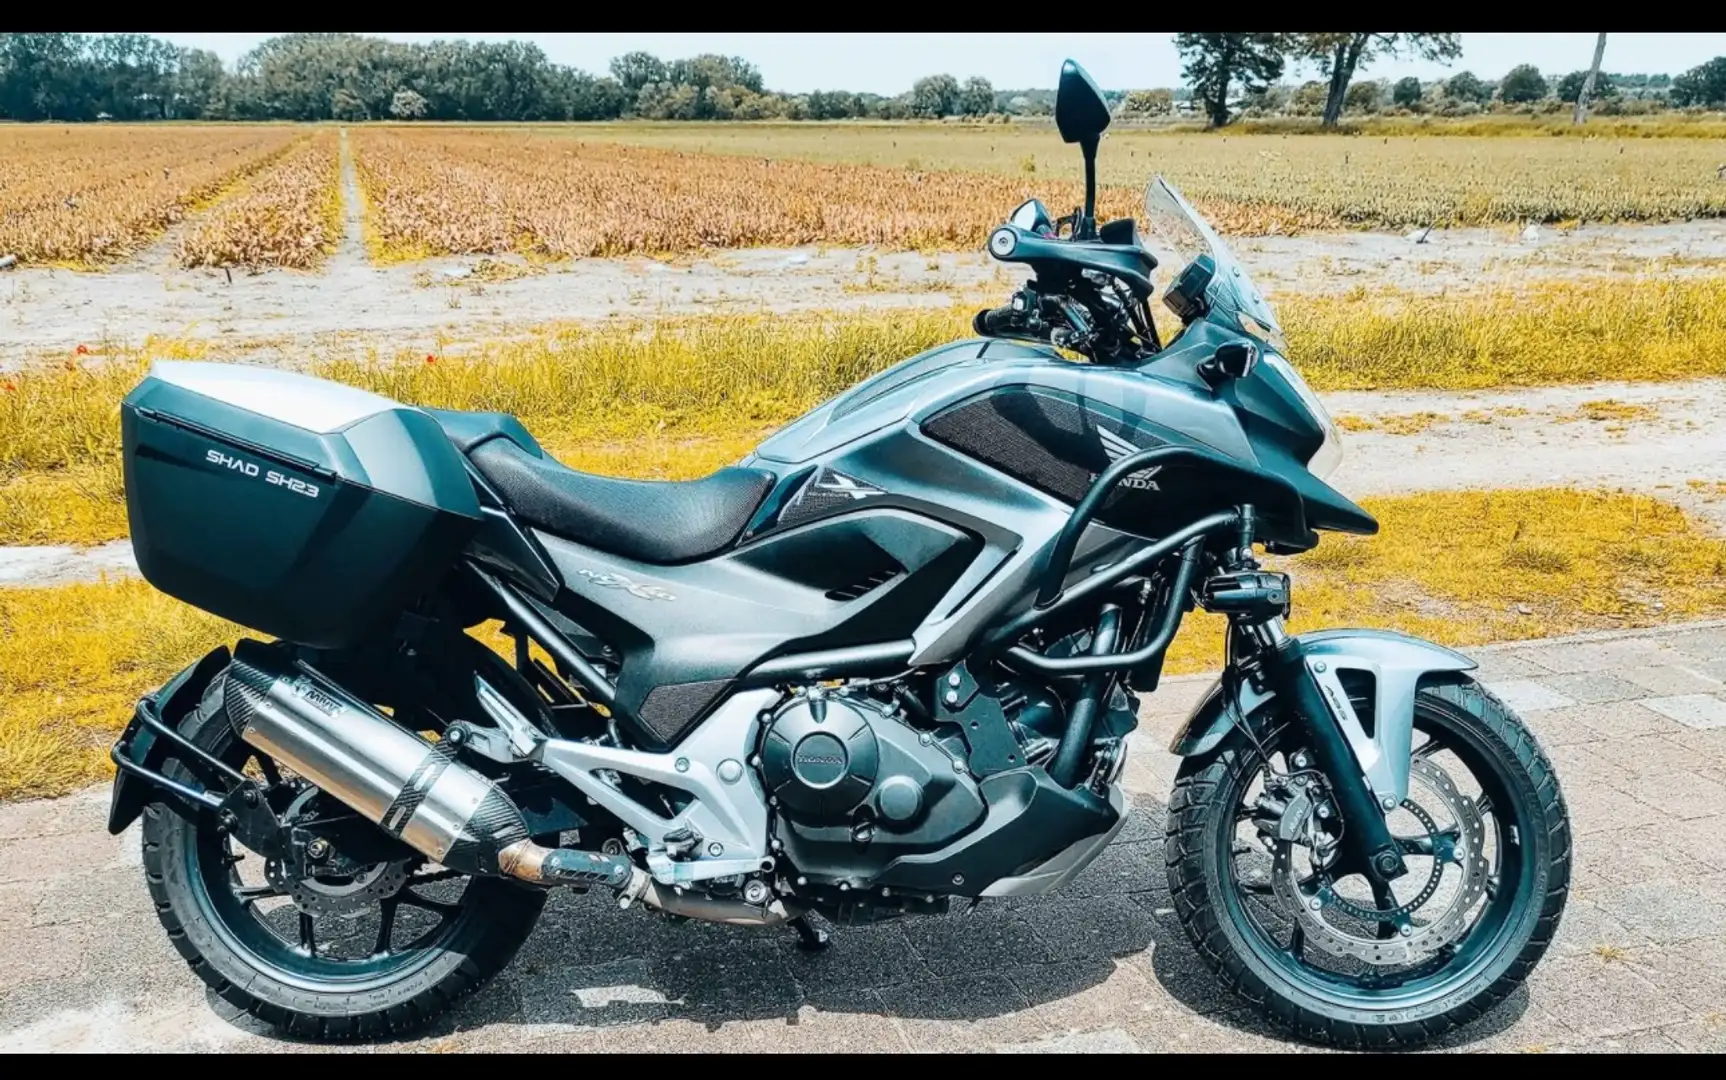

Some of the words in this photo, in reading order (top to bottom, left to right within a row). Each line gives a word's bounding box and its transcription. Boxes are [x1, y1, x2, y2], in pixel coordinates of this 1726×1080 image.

[206, 449, 259, 477] SHAD
[265, 470, 320, 498] SH23
[1089, 472, 1161, 491] HNDA
